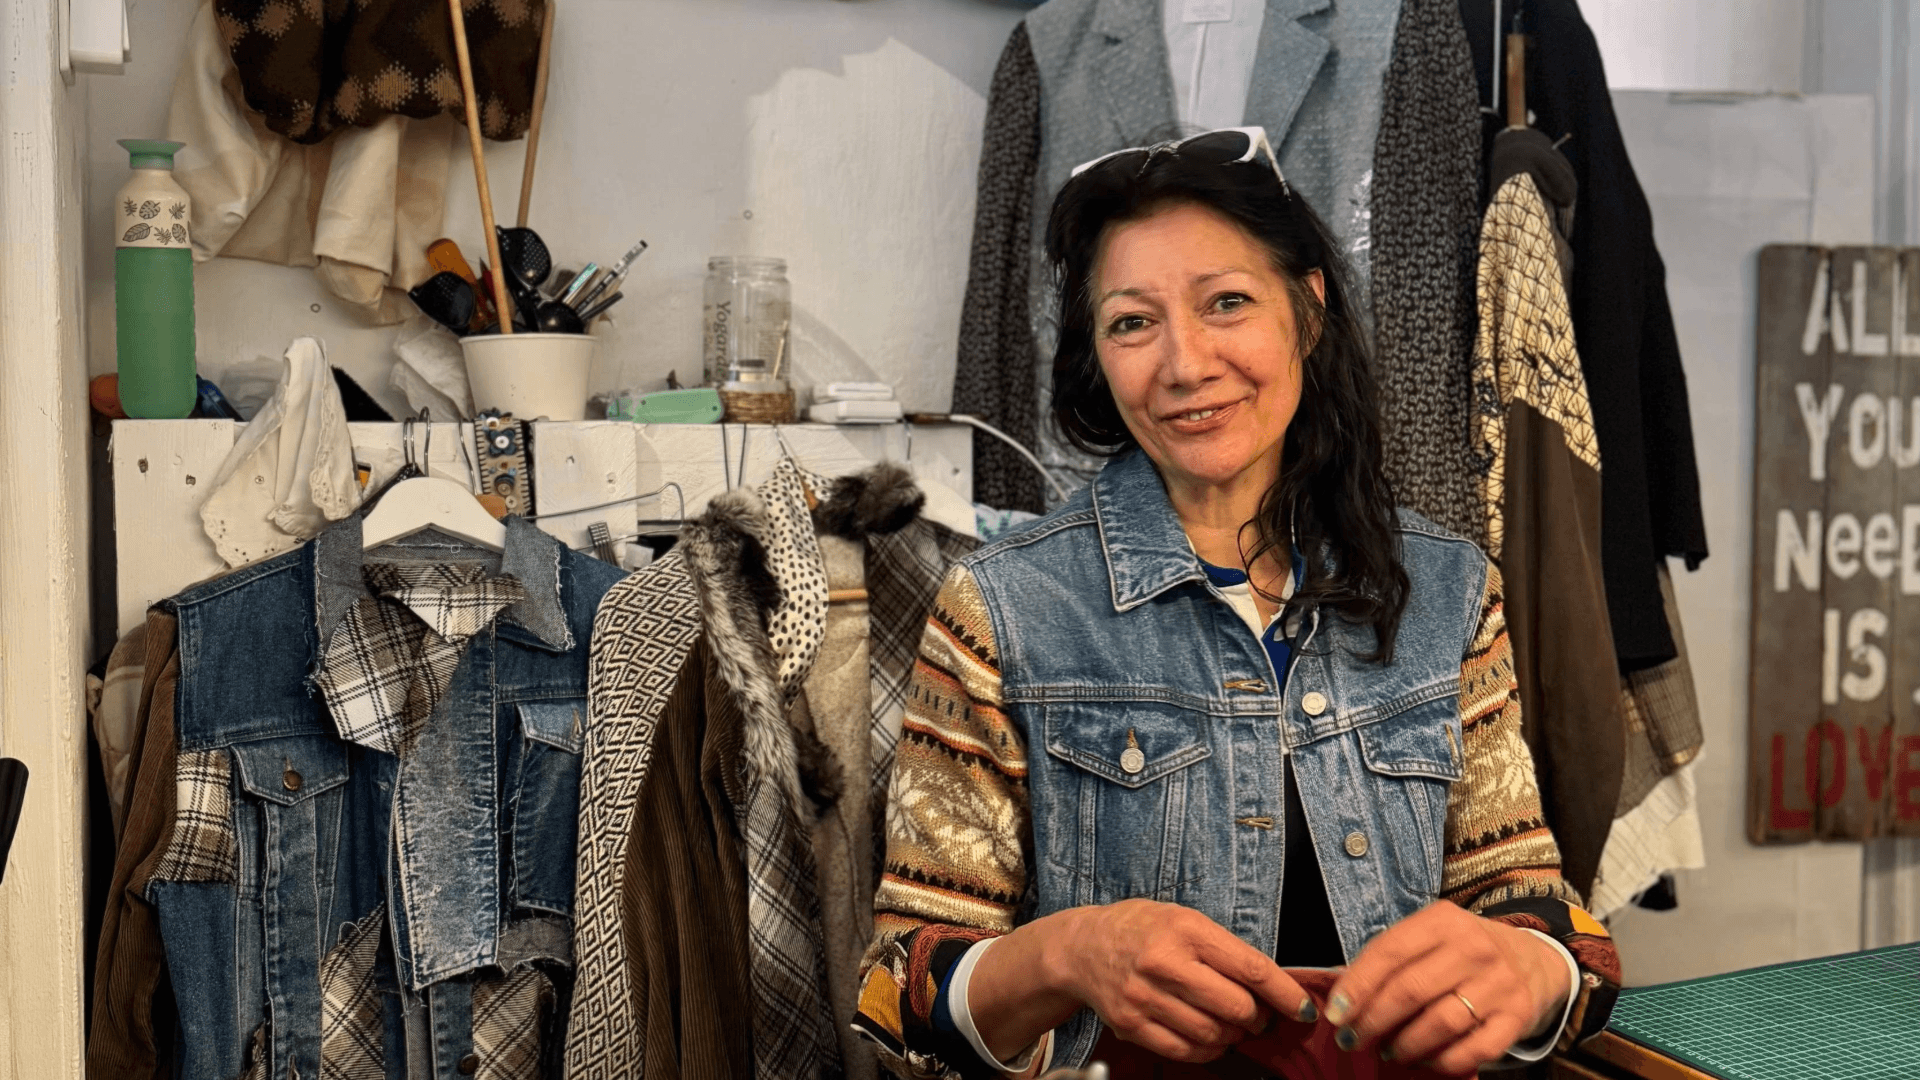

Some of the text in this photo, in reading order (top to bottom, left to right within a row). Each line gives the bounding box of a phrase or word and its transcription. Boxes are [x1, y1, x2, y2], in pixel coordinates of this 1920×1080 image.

[1802, 259, 1920, 356] ALL
[1795, 383, 1920, 481] YOU
[1822, 607, 1889, 704] IS
[1769, 719, 1920, 830] LOVE
